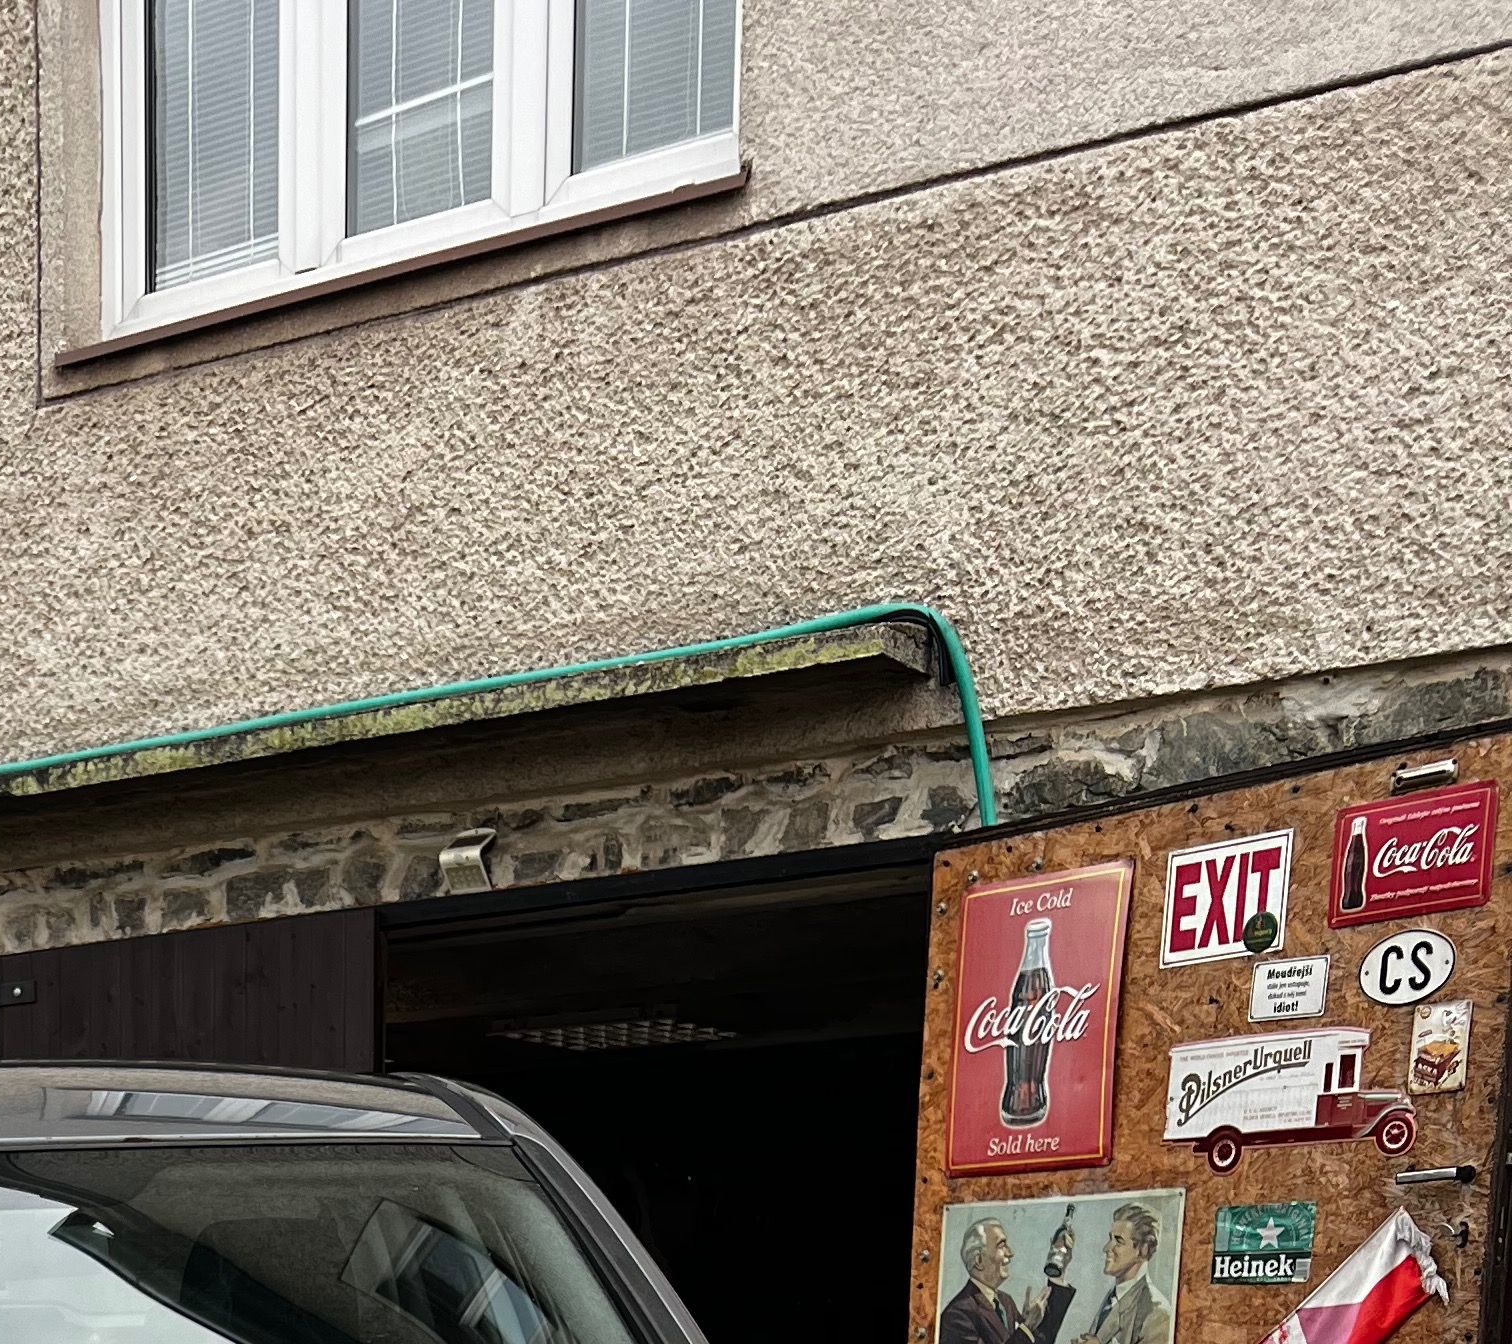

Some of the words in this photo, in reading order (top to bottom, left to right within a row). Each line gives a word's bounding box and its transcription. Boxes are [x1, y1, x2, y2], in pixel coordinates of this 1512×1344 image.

[1372, 823, 1480, 878] Coca-Cola
[1009, 898, 1033, 916] Ice
[1037, 888, 1073, 912] Cold
[1169, 846, 1282, 953] EXIT
[1379, 940, 1434, 995] CS
[964, 983, 1100, 1054] Coca-Cola
[1273, 1000, 1299, 1013] idiot!
[1177, 1058, 1252, 1127] Pilsner
[1253, 1039, 1313, 1074] Urquell
[987, 1136, 1022, 1156] Sold
[1025, 1134, 1059, 1153] here
[1213, 1254, 1294, 1278] Heinek
